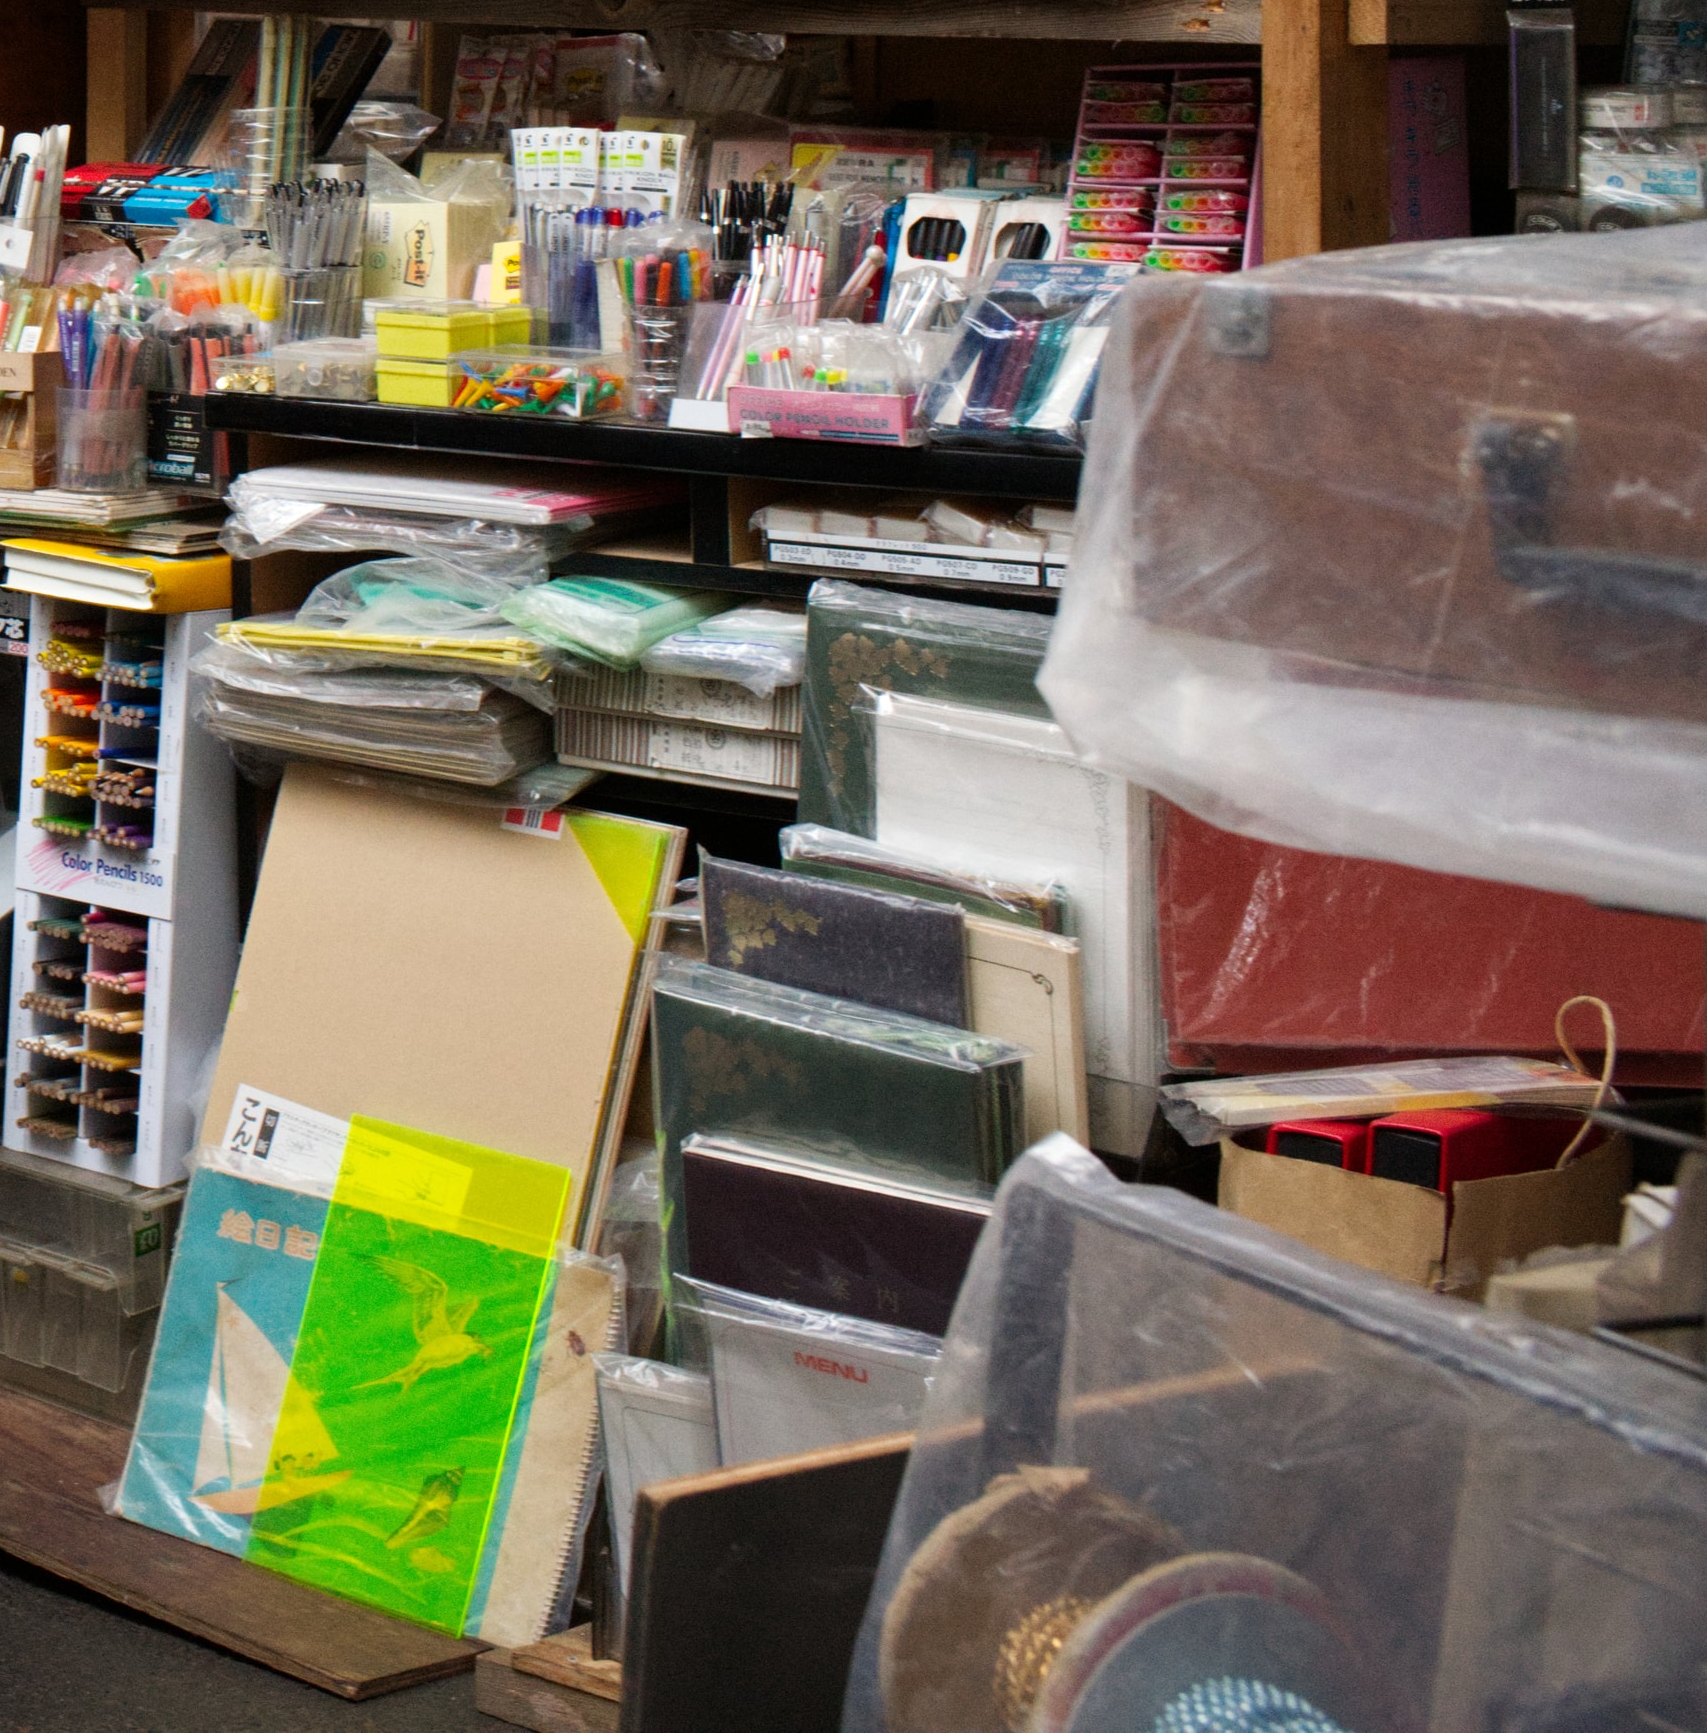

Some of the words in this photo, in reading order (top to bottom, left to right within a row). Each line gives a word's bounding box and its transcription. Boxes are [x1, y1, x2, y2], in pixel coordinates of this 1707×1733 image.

[414, 228, 426, 284] Post-it
[739, 409, 780, 421] COLOR
[836, 416, 890, 430] HOLDER
[8, 641, 29, 655] 200
[60, 851, 93, 873] Color
[96, 857, 138, 883] Pencils
[138, 871, 164, 888] 1500
[216, 1208, 319, 1262] 絵日記
[792, 1350, 870, 1385] MENU
